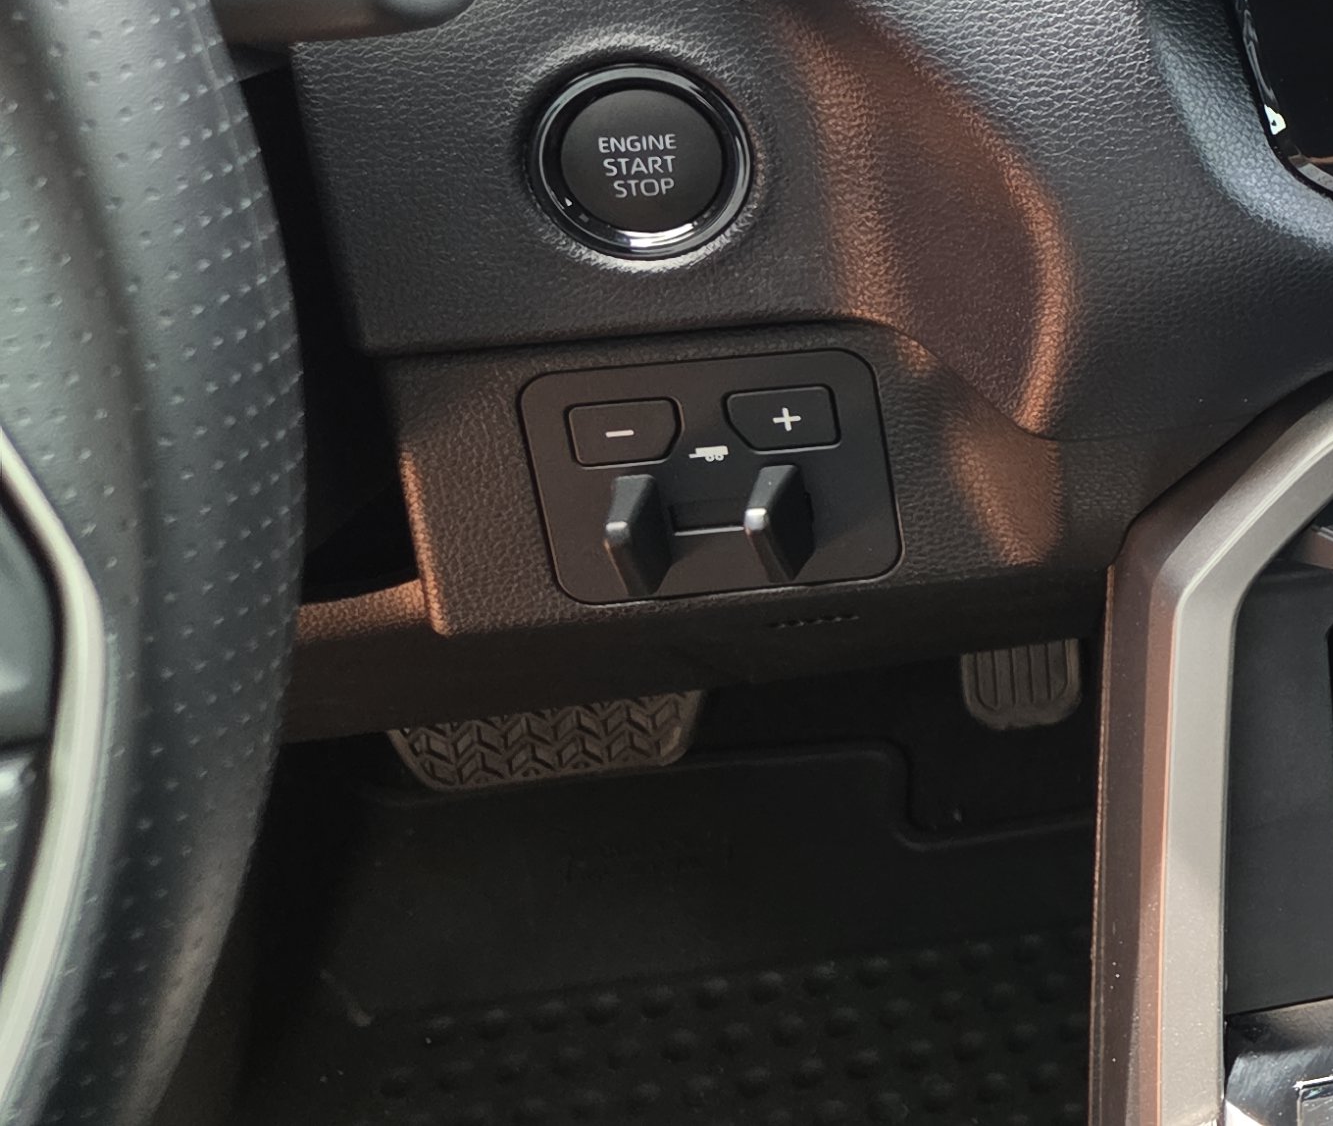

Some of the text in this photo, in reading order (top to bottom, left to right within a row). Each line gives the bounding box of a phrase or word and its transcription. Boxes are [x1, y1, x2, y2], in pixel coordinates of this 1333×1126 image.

[598, 133, 678, 154] ENGINE
[603, 155, 677, 177] START
[613, 177, 676, 199] STOP
